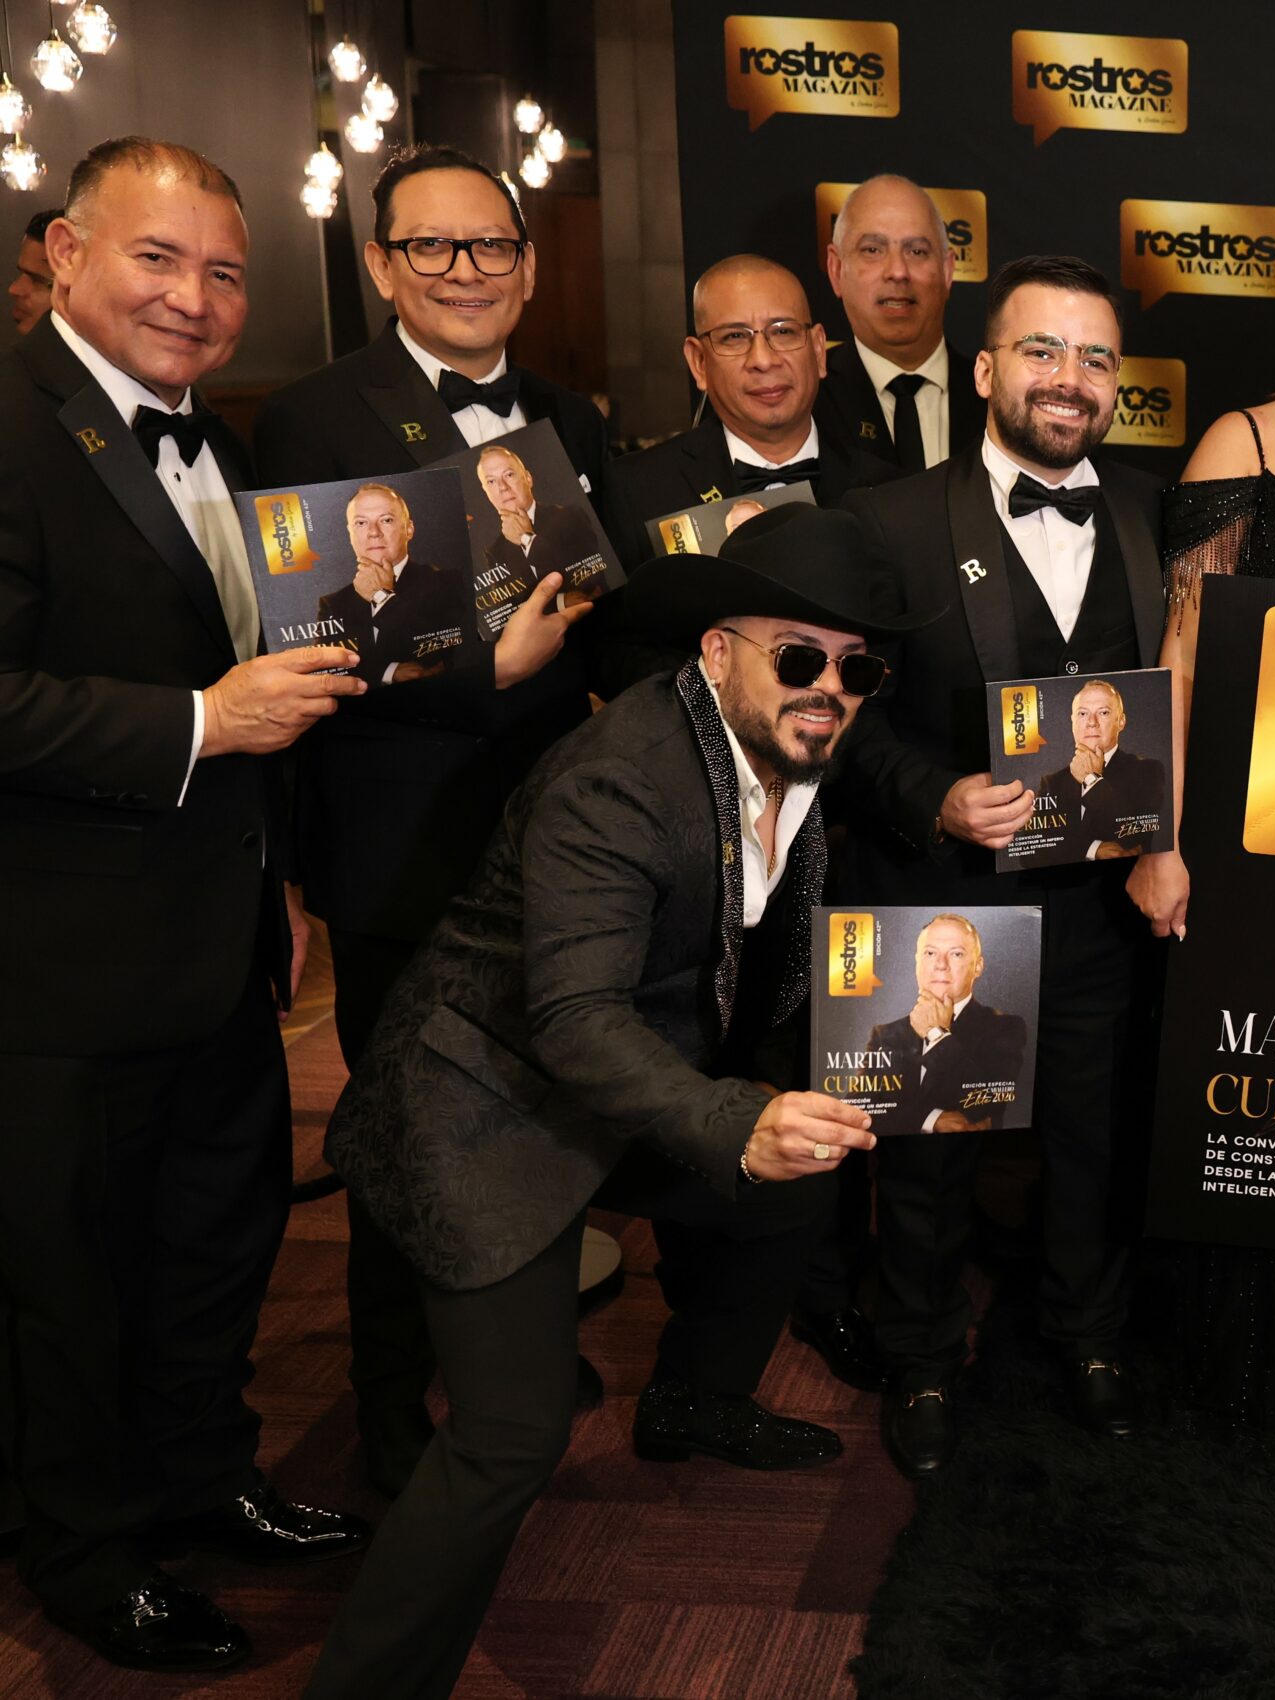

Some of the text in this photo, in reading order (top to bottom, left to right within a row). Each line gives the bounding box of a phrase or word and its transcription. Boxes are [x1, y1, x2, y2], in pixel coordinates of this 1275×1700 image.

[739, 42, 884, 80] rostros
[783, 78, 884, 97] MAGAZINE
[1027, 58, 1173, 97] rostros
[1069, 94, 1172, 113] MAGAZINE
[1114, 412, 1171, 427] AZINE
[74, 427, 106, 454] R
[400, 422, 427, 442] R
[272, 502, 296, 567] rostros
[960, 559, 987, 584] R
[280, 615, 345, 642] MARTÍN
[1011, 692, 1026, 749] rostros
[1024, 813, 1067, 831] RIMAN
[840, 920, 856, 989] rostros
[826, 1047, 892, 1069] MARTÍN
[824, 1074, 903, 1093] CURIMAN
[1207, 1133, 1228, 1145] LA
[1206, 1149, 1225, 1161] DE
[1204, 1165, 1253, 1180] DESDE
